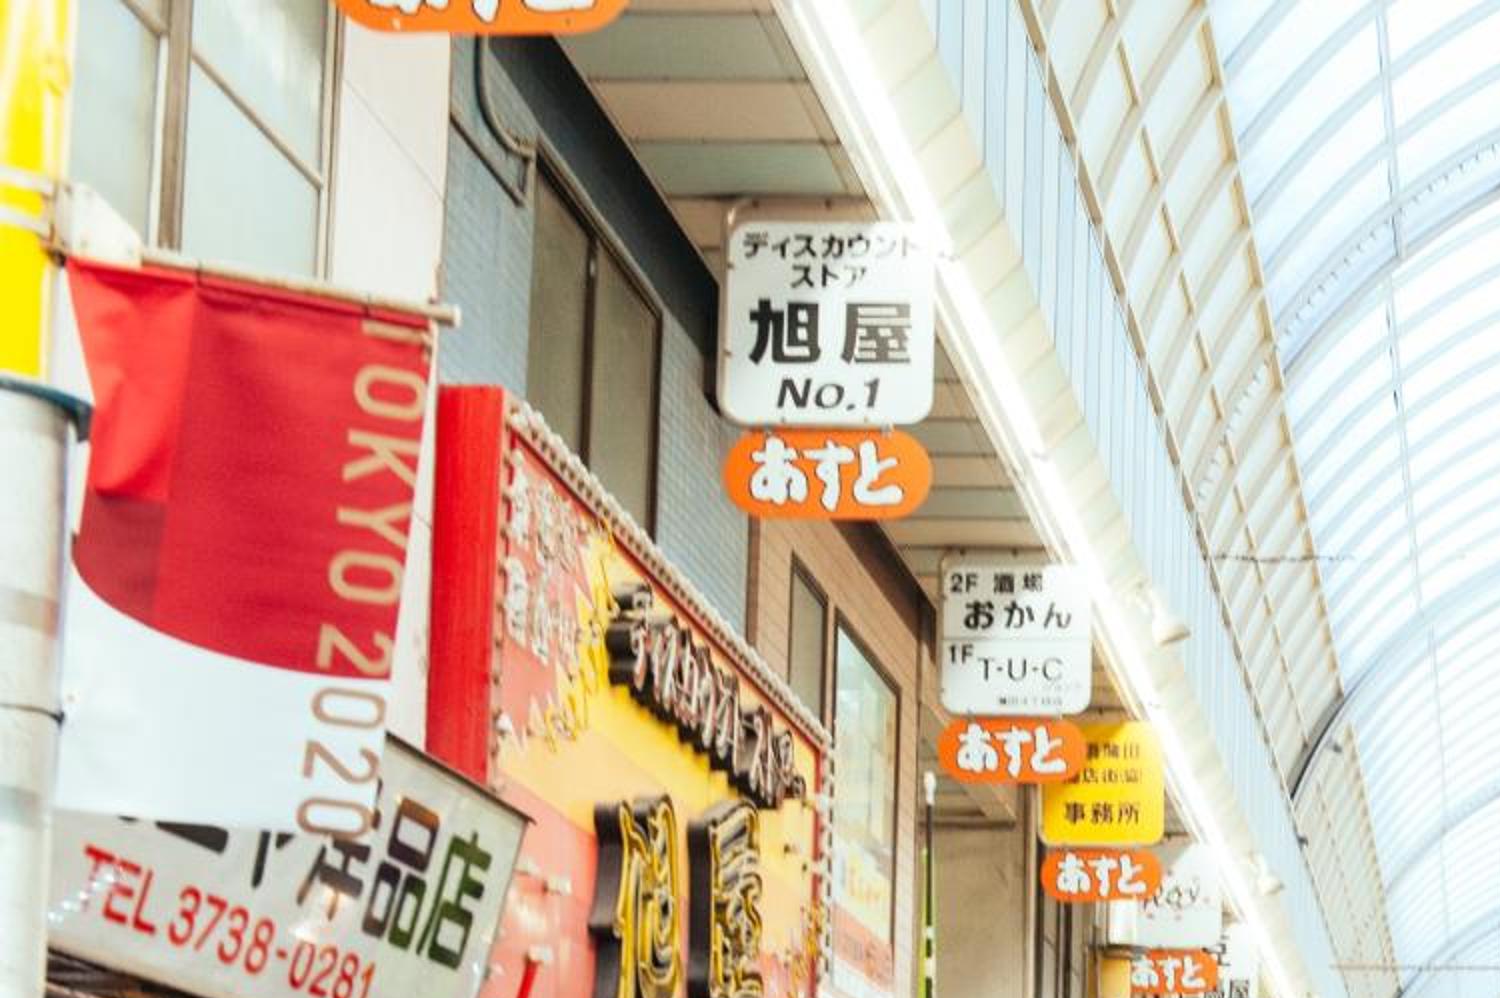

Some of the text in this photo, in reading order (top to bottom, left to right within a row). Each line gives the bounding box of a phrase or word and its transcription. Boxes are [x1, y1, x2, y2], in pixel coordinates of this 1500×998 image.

[742, 231, 917, 261] ディスカウント
[747, 298, 913, 366] 旭屋
[776, 377, 881, 410] No.1
[748, 436, 905, 513] あすと
[296, 318, 434, 846] TOKYO 2020
[951, 572, 978, 594] 2F
[963, 598, 1073, 631] おかん
[948, 643, 974, 665] 1F
[956, 721, 1068, 779] あすと
[82, 843, 156, 935] TEL
[1056, 852, 1147, 897] あすと
[1131, 954, 1207, 992] あすと
